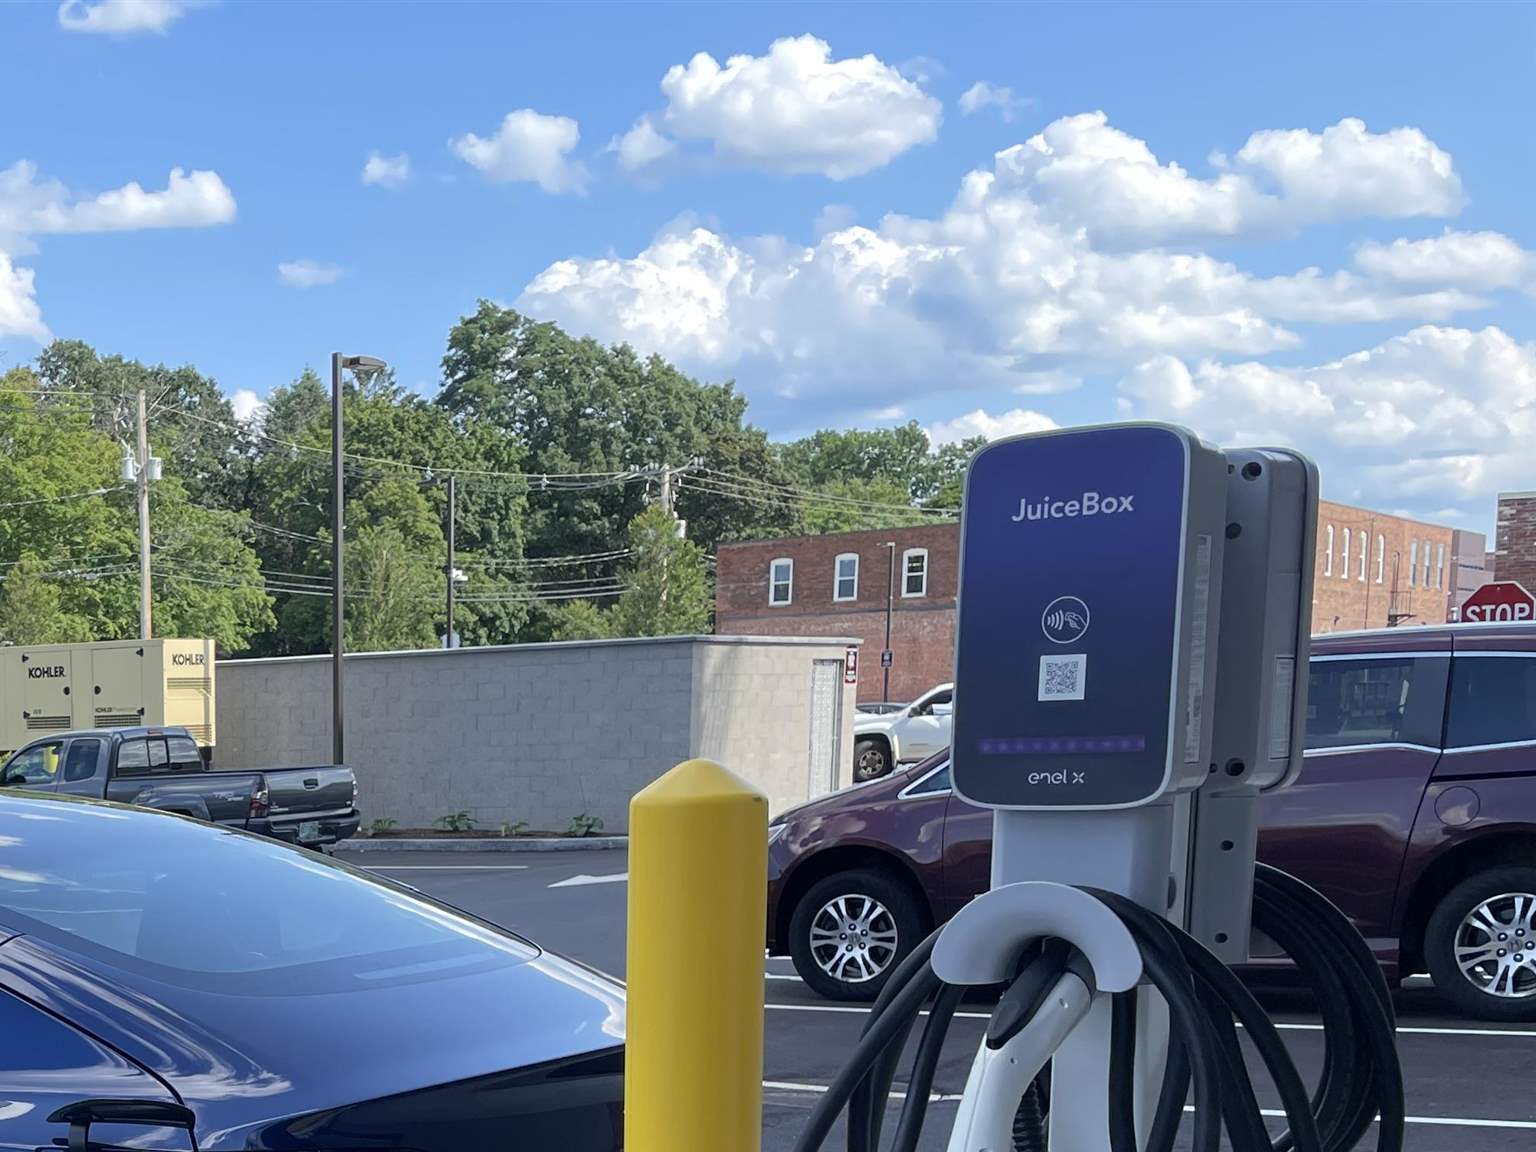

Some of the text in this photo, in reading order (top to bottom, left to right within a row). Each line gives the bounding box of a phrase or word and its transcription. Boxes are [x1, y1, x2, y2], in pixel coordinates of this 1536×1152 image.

[1011, 491, 1135, 522] JuiceBox
[1466, 602, 1531, 622] STOP
[172, 653, 205, 666] KOHLER
[28, 666, 65, 679] KOHLER
[1028, 768, 1067, 785] enel
